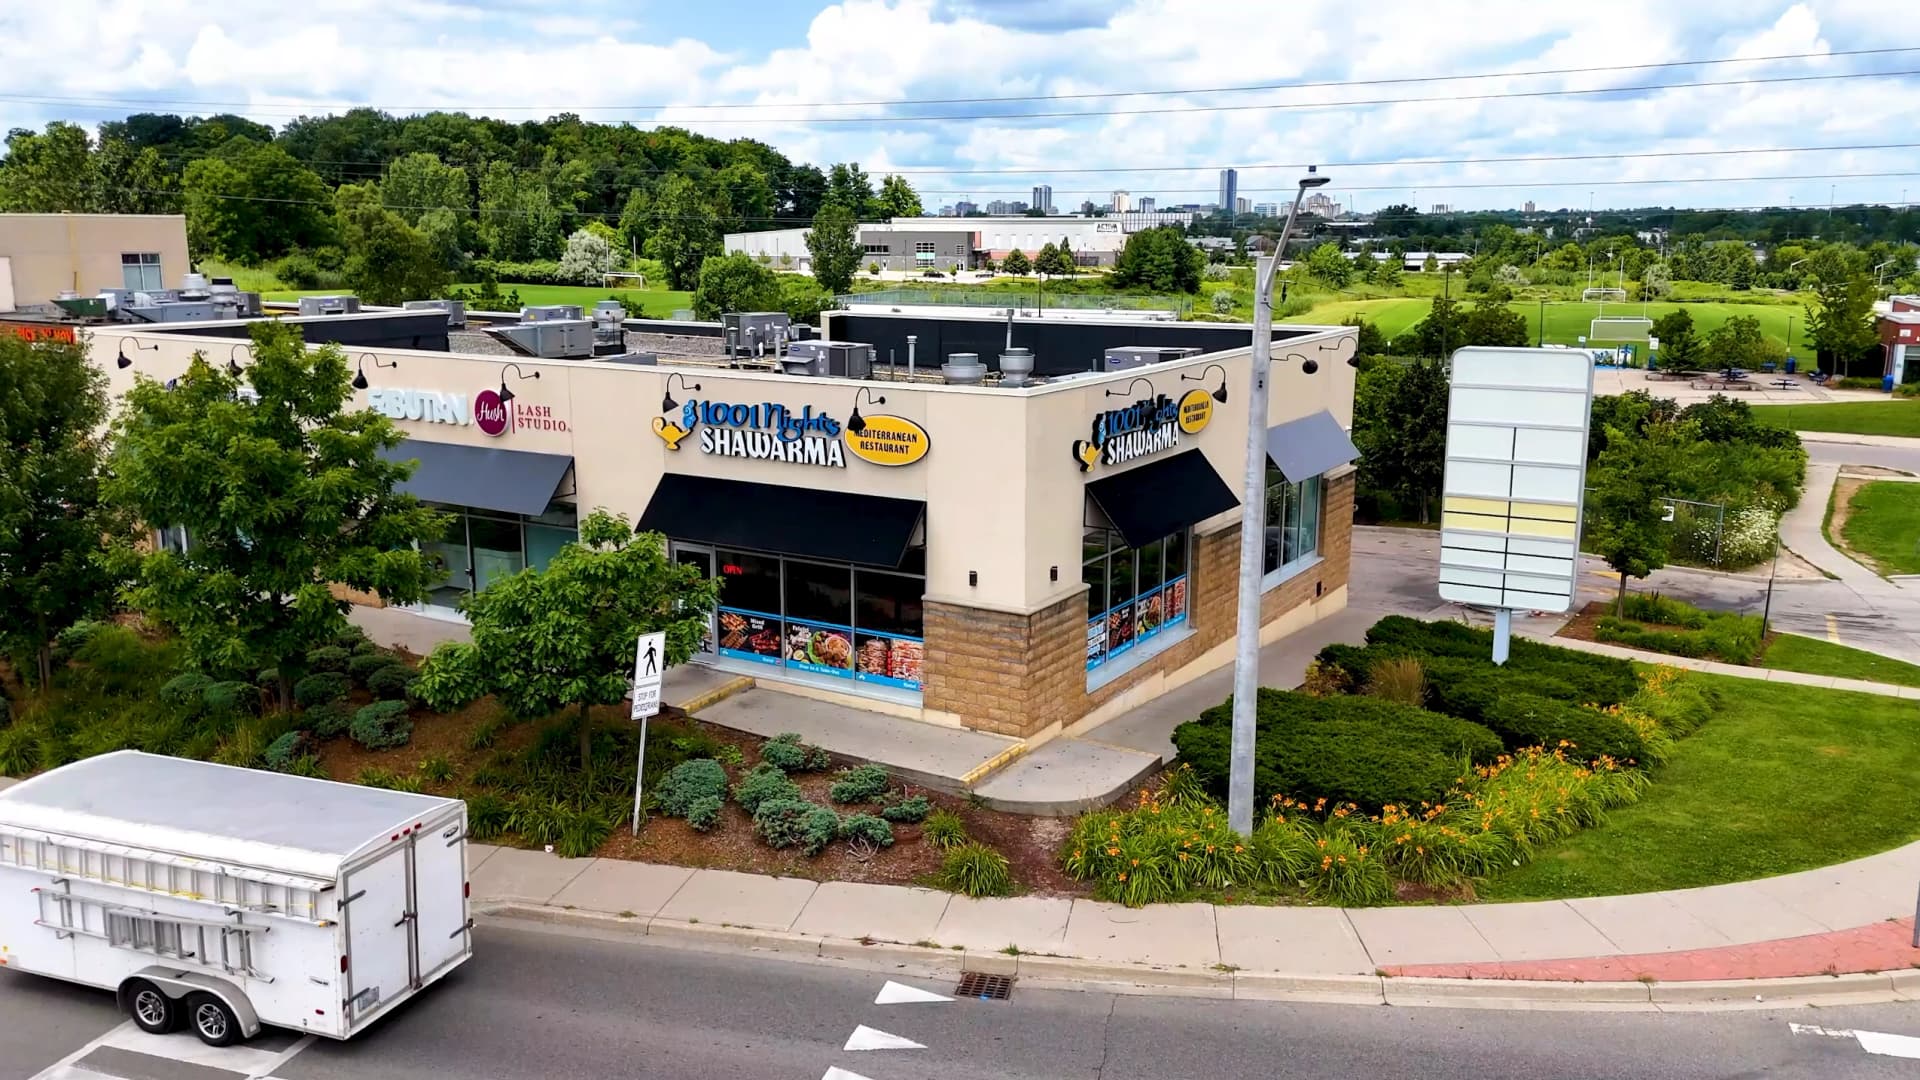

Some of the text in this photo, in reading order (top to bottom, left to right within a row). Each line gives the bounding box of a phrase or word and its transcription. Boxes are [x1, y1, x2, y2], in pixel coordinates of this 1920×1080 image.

[477, 401, 504, 422] Hush
[517, 404, 551, 418] LASH
[518, 417, 567, 432] STUDIO
[700, 400, 841, 442] 1001 Nights
[700, 427, 846, 468] SHAWARMA
[860, 440, 910, 455] RESTAURANT
[1106, 421, 1180, 466] SHAWARMA
[723, 565, 742, 575] OPEN
